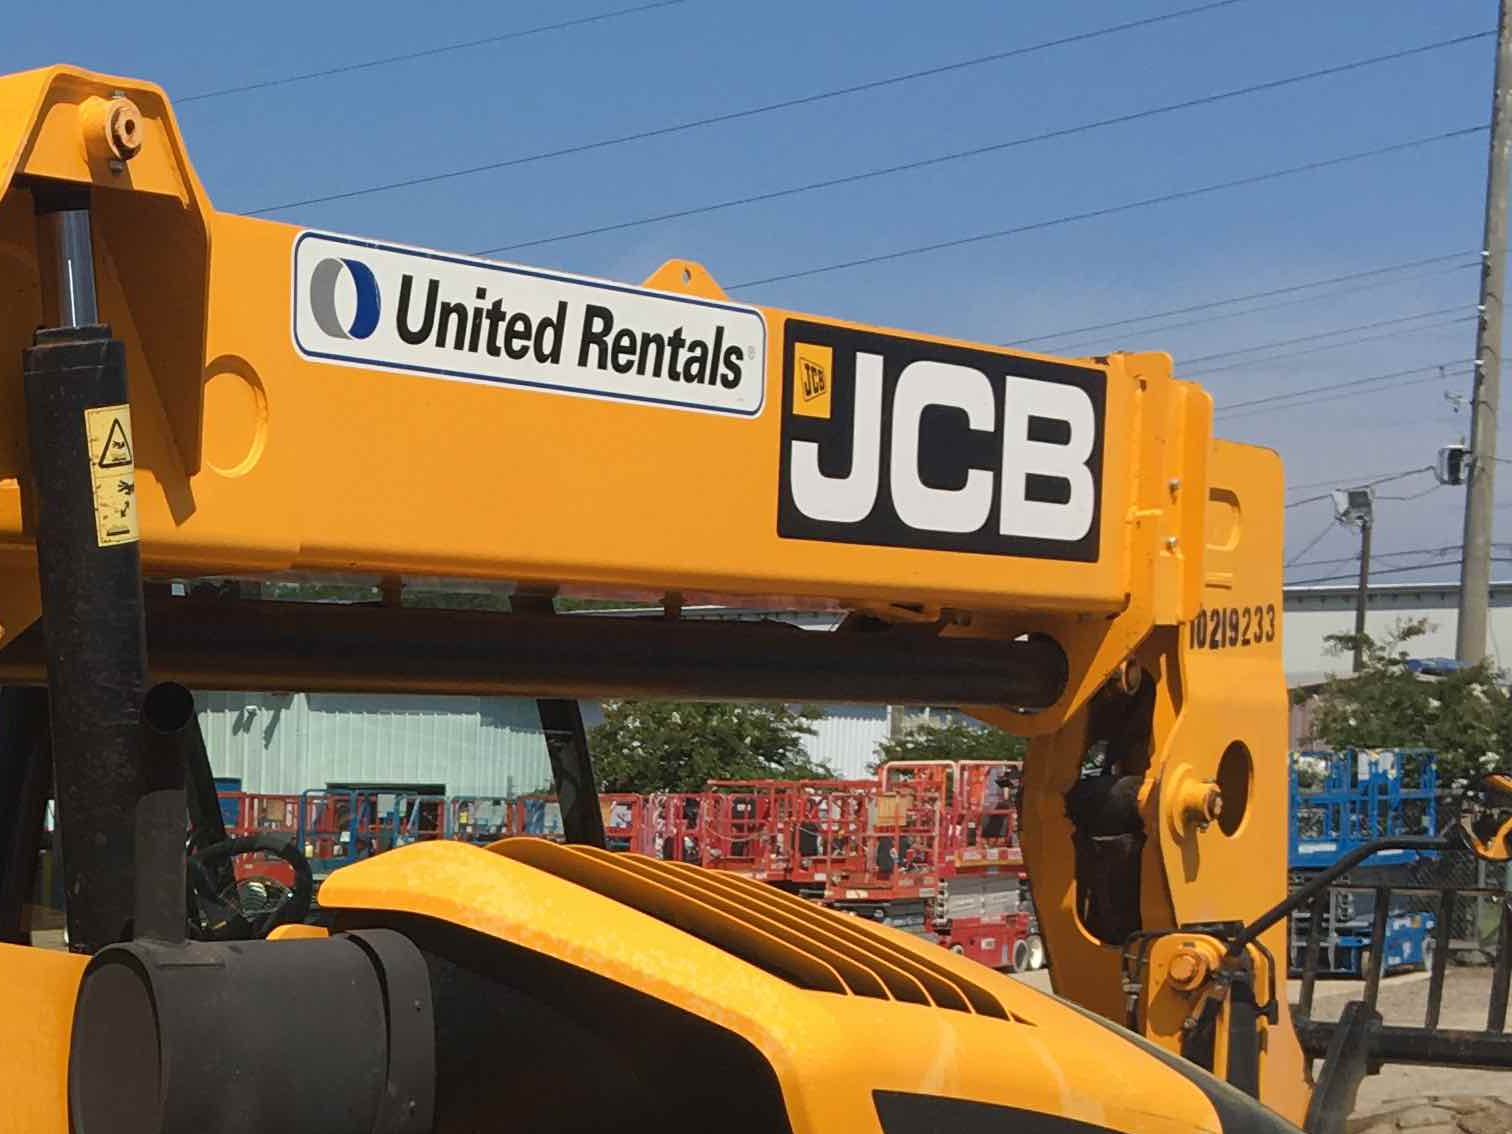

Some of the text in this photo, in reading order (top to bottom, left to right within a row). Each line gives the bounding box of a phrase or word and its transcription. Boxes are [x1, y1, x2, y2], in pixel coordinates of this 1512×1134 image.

[395, 274, 745, 391] United Rentals
[803, 363, 825, 397] JCB
[791, 351, 1096, 542] JCB
[1190, 603, 1276, 649] 10219233
